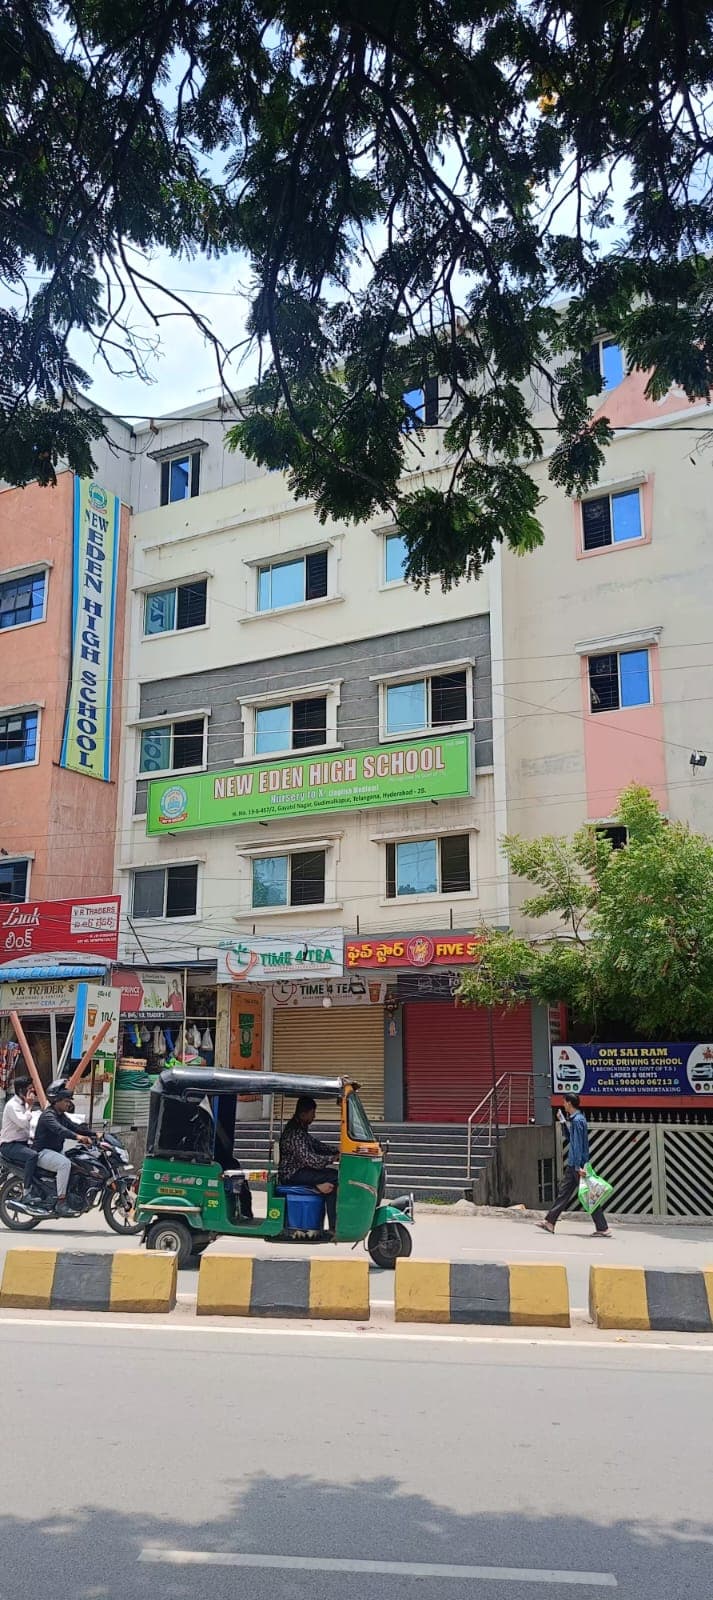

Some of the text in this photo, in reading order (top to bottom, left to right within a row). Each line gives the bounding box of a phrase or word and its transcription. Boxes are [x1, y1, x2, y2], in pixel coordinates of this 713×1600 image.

[85, 509, 109, 533] NEW
[84, 527, 106, 594] EDEN
[82, 596, 103, 665] HIGH
[76, 670, 98, 769] SCHOOL
[214, 745, 446, 799] NEW EDEN HIGH SCHOOL
[270, 791, 306, 804] Nursery
[262, 951, 292, 967] TIME
[307, 948, 334, 962] TEA
[436, 943, 464, 956] FIVE
[300, 985, 324, 995] TIME
[326, 984, 333, 994] 4
[599, 1048, 668, 1057] OM SAI RAM
